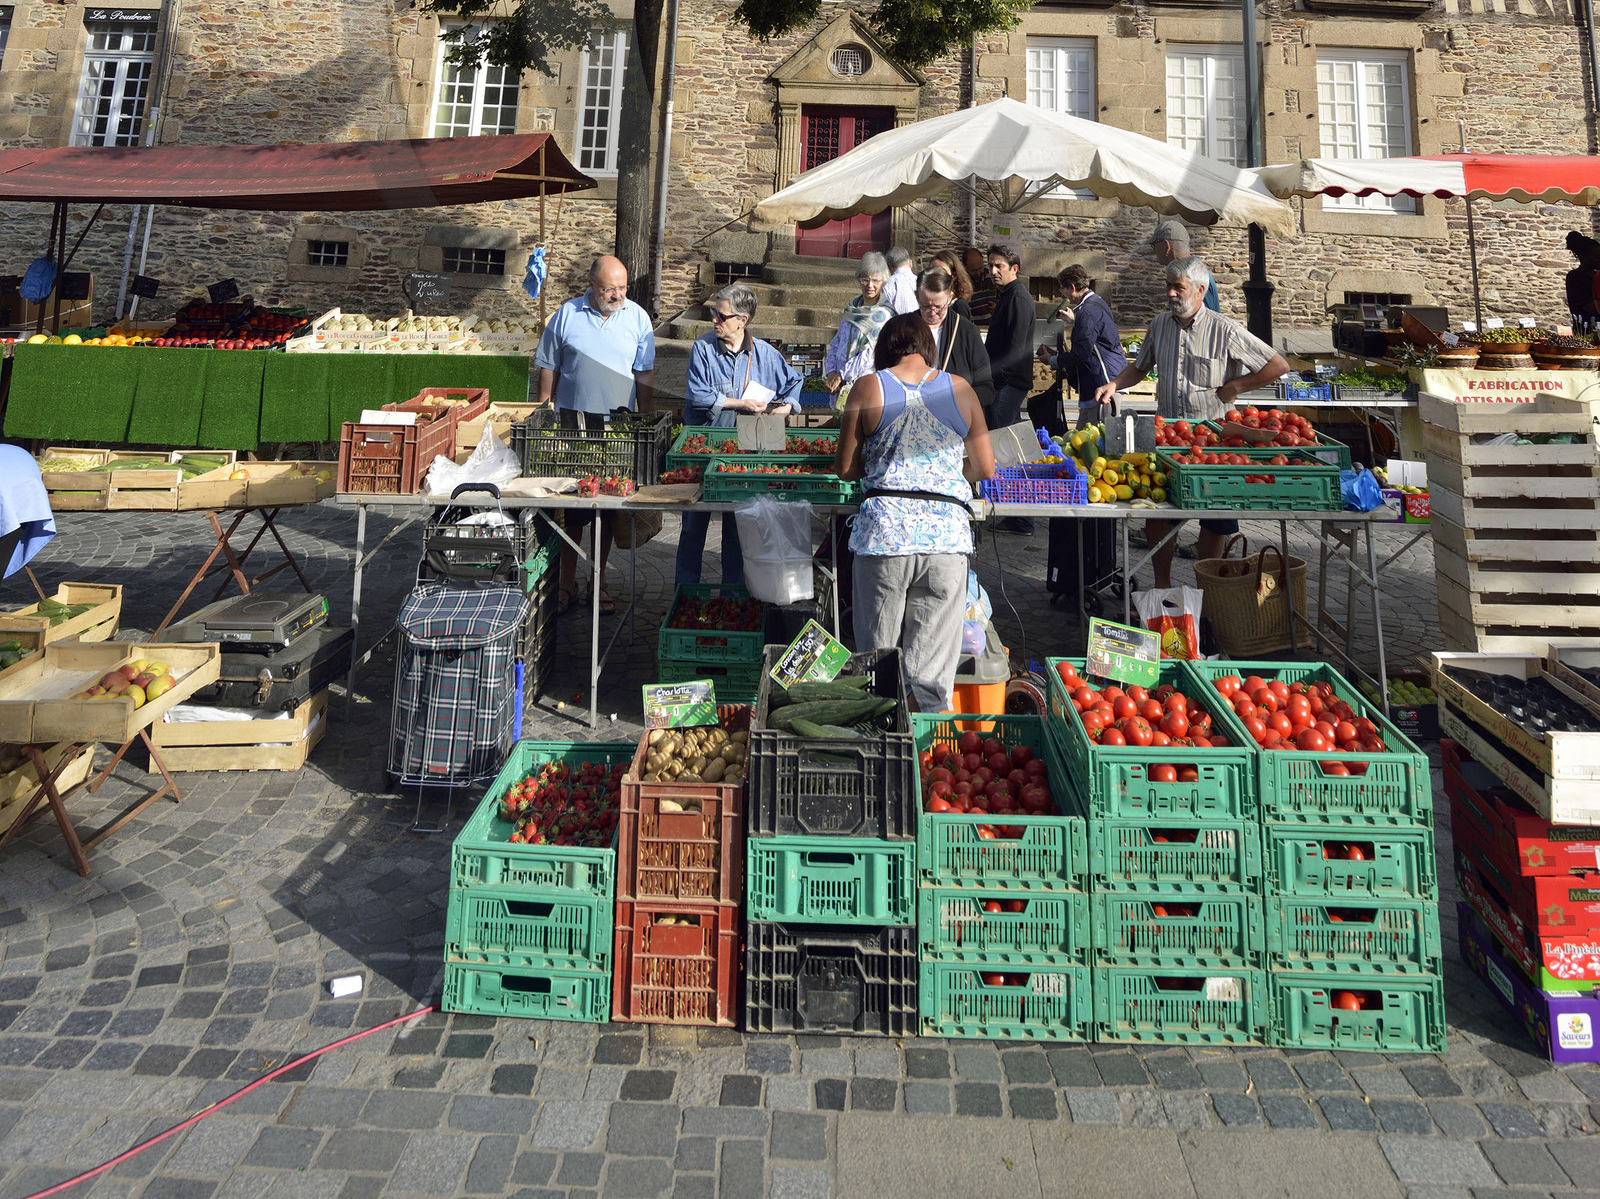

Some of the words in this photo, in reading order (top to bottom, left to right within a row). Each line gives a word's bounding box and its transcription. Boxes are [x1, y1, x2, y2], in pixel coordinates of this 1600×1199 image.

[89, 10, 107, 19] La
[110, 10, 152, 20] Poudrerie
[1468, 381, 1563, 390] FABRICATION
[656, 686, 692, 696] Charlotte
[1545, 943, 1562, 954] La
[1561, 1031, 1591, 1041] Saveurs
